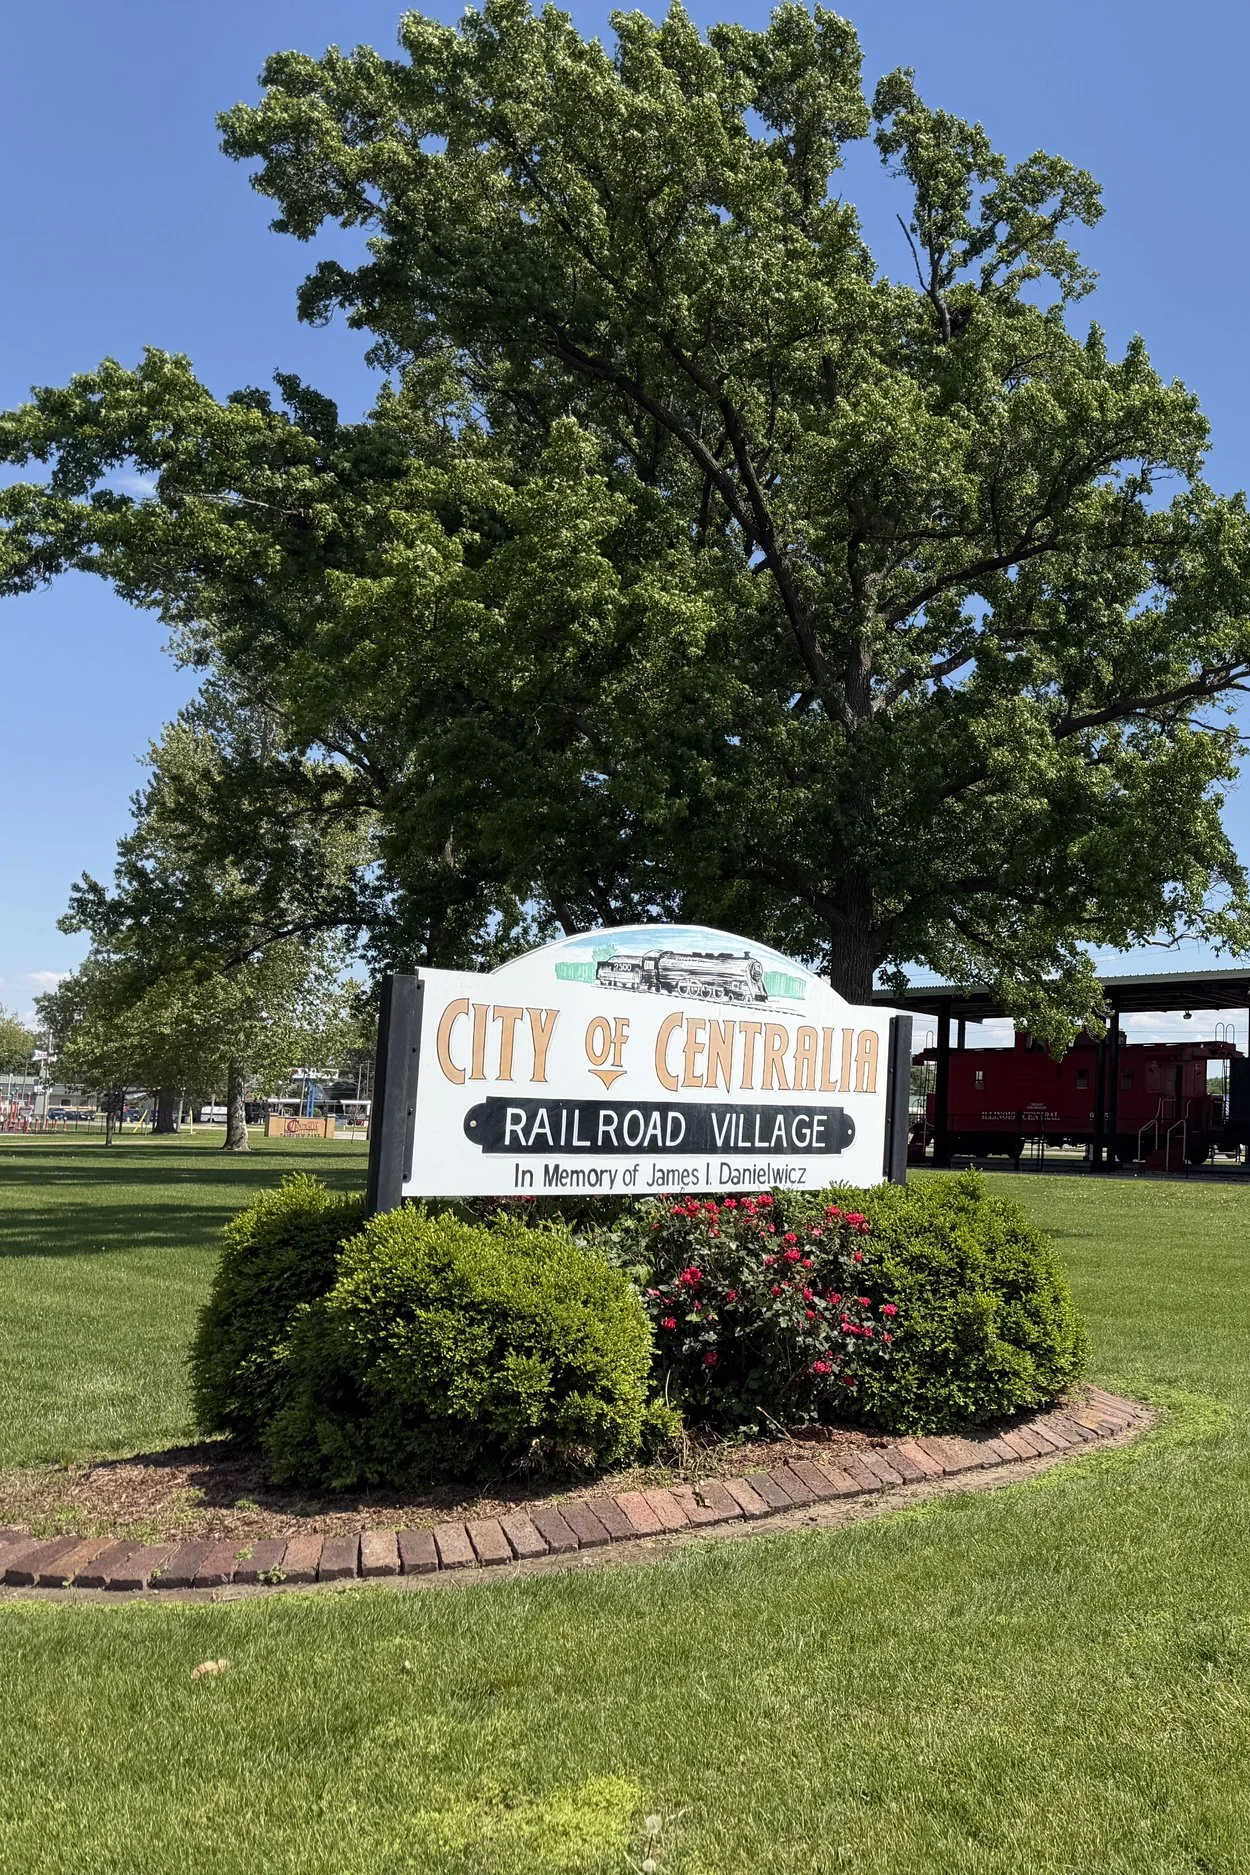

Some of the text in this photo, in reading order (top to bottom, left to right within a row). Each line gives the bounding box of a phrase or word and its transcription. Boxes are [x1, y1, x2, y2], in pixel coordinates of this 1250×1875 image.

[436, 998, 879, 1094] CITY OF CENTRALIA
[504, 1107, 828, 1148] RAILROAD VILLAGE
[981, 1111, 1016, 1121] ILLINOIS
[1022, 1111, 1060, 1121] CENTRAL
[514, 1163, 534, 1188] In
[543, 1163, 618, 1190] Memory
[622, 1163, 640, 1187] of
[646, 1163, 700, 1187] James
[719, 1162, 807, 1185] Danielwicz
